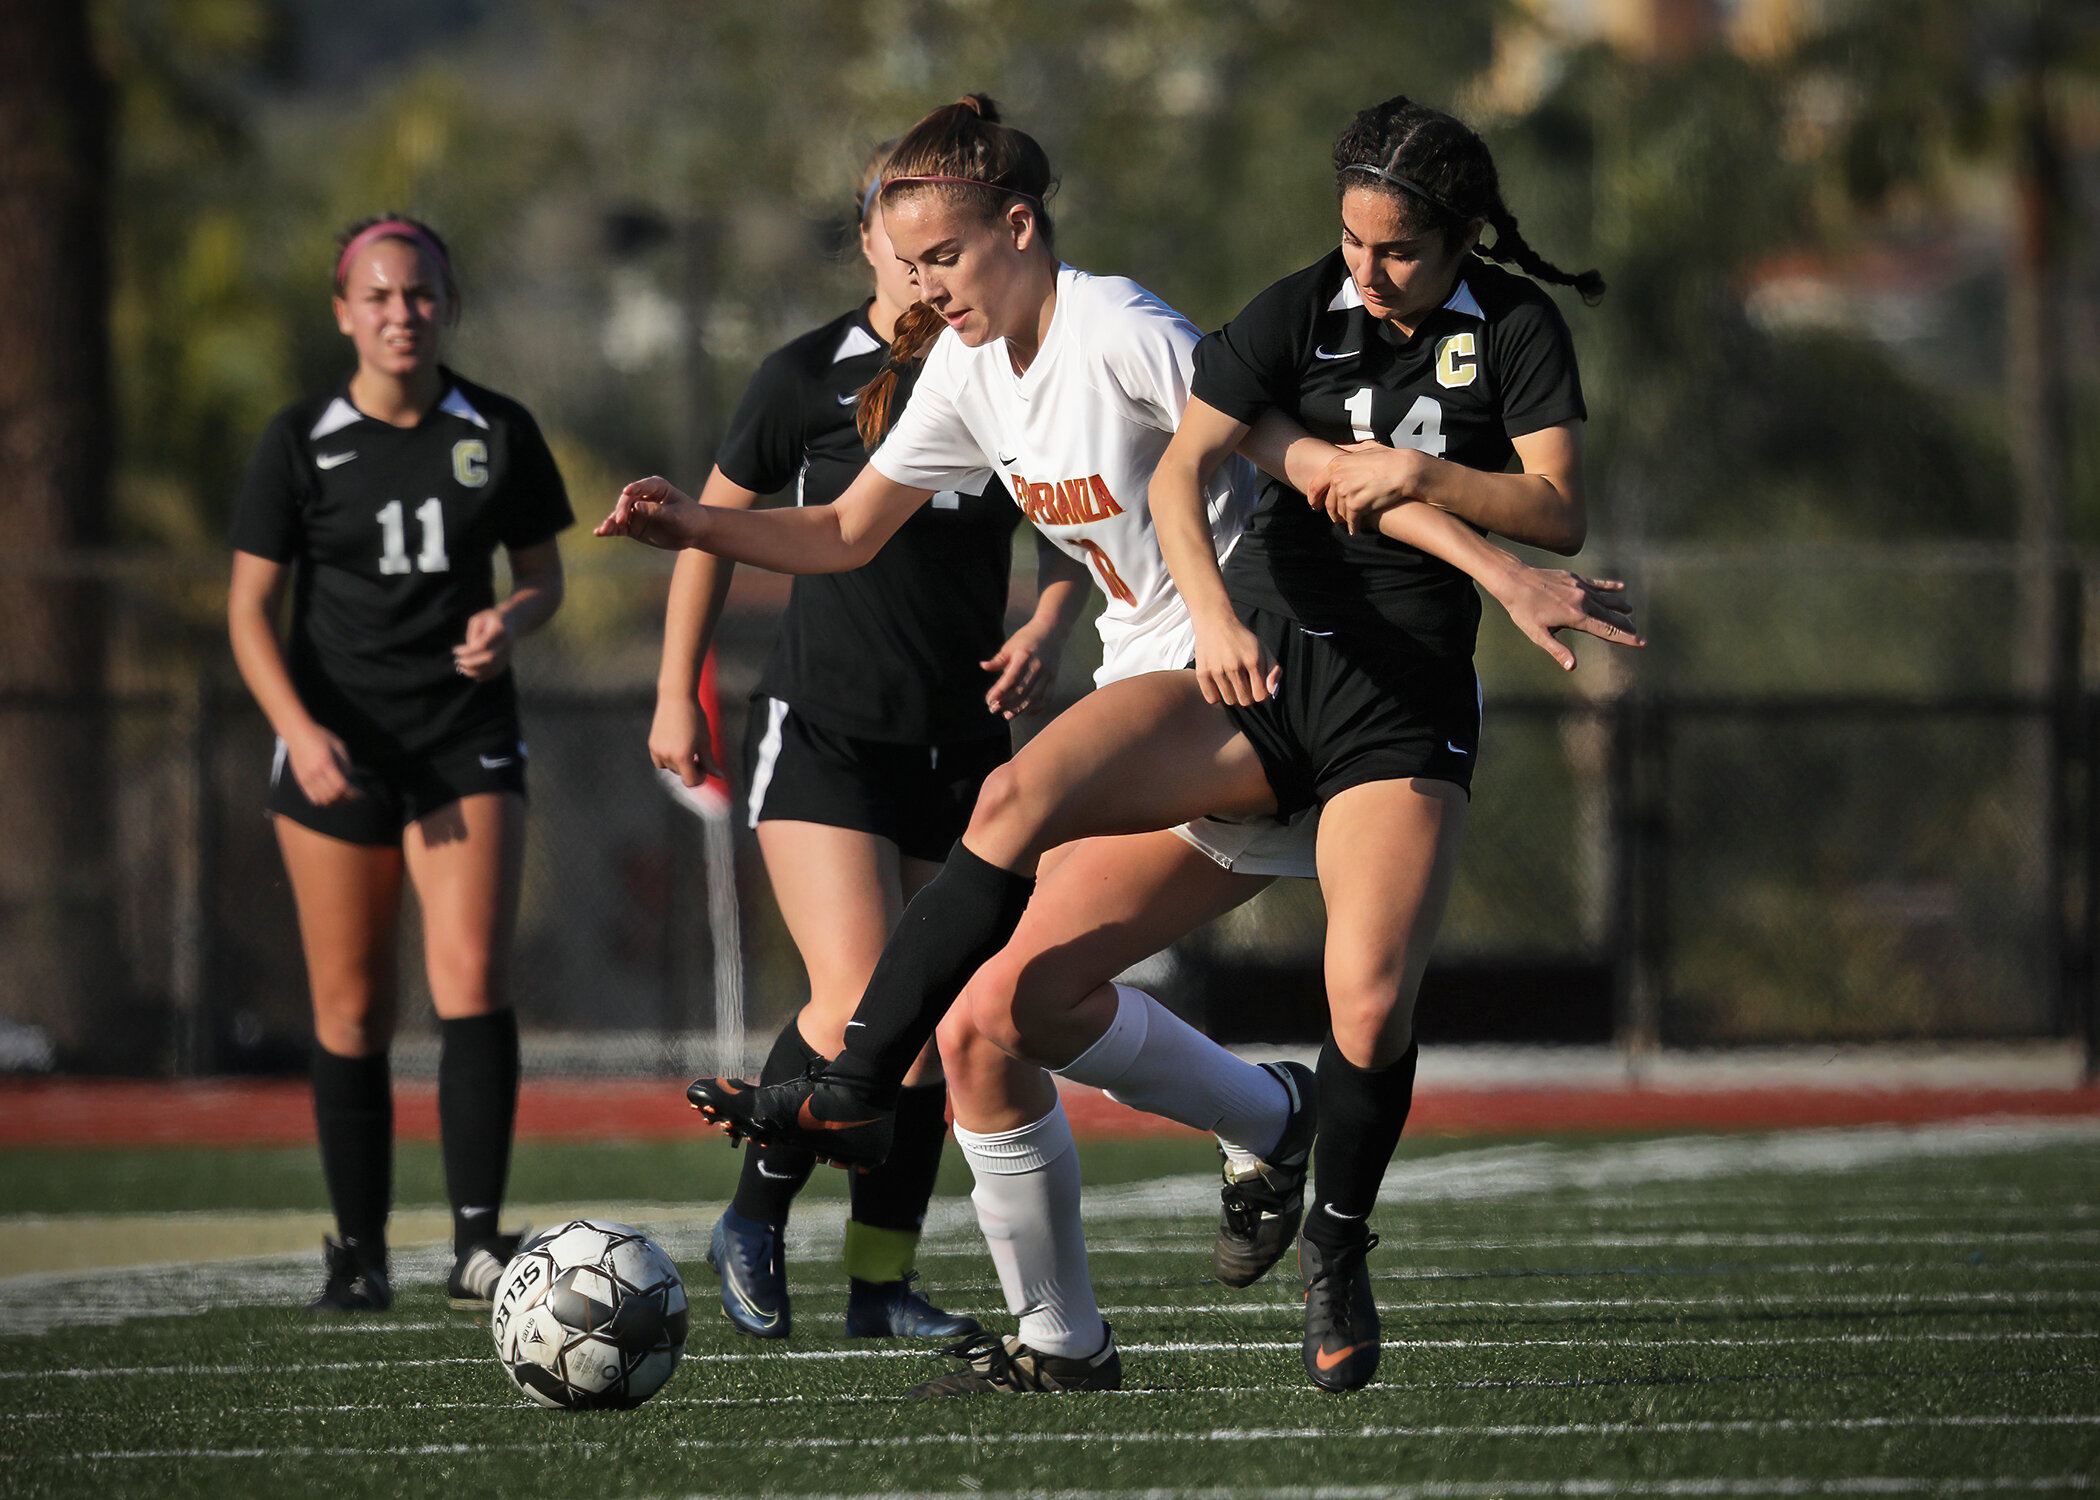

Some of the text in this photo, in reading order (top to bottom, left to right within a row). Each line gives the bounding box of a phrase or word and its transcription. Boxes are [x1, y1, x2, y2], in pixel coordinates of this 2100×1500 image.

[1435, 332, 1478, 389] C
[1344, 387, 1447, 460] 14
[452, 439, 489, 488] C
[376, 497, 450, 575] 11
[495, 1260, 541, 1344] SELEC
